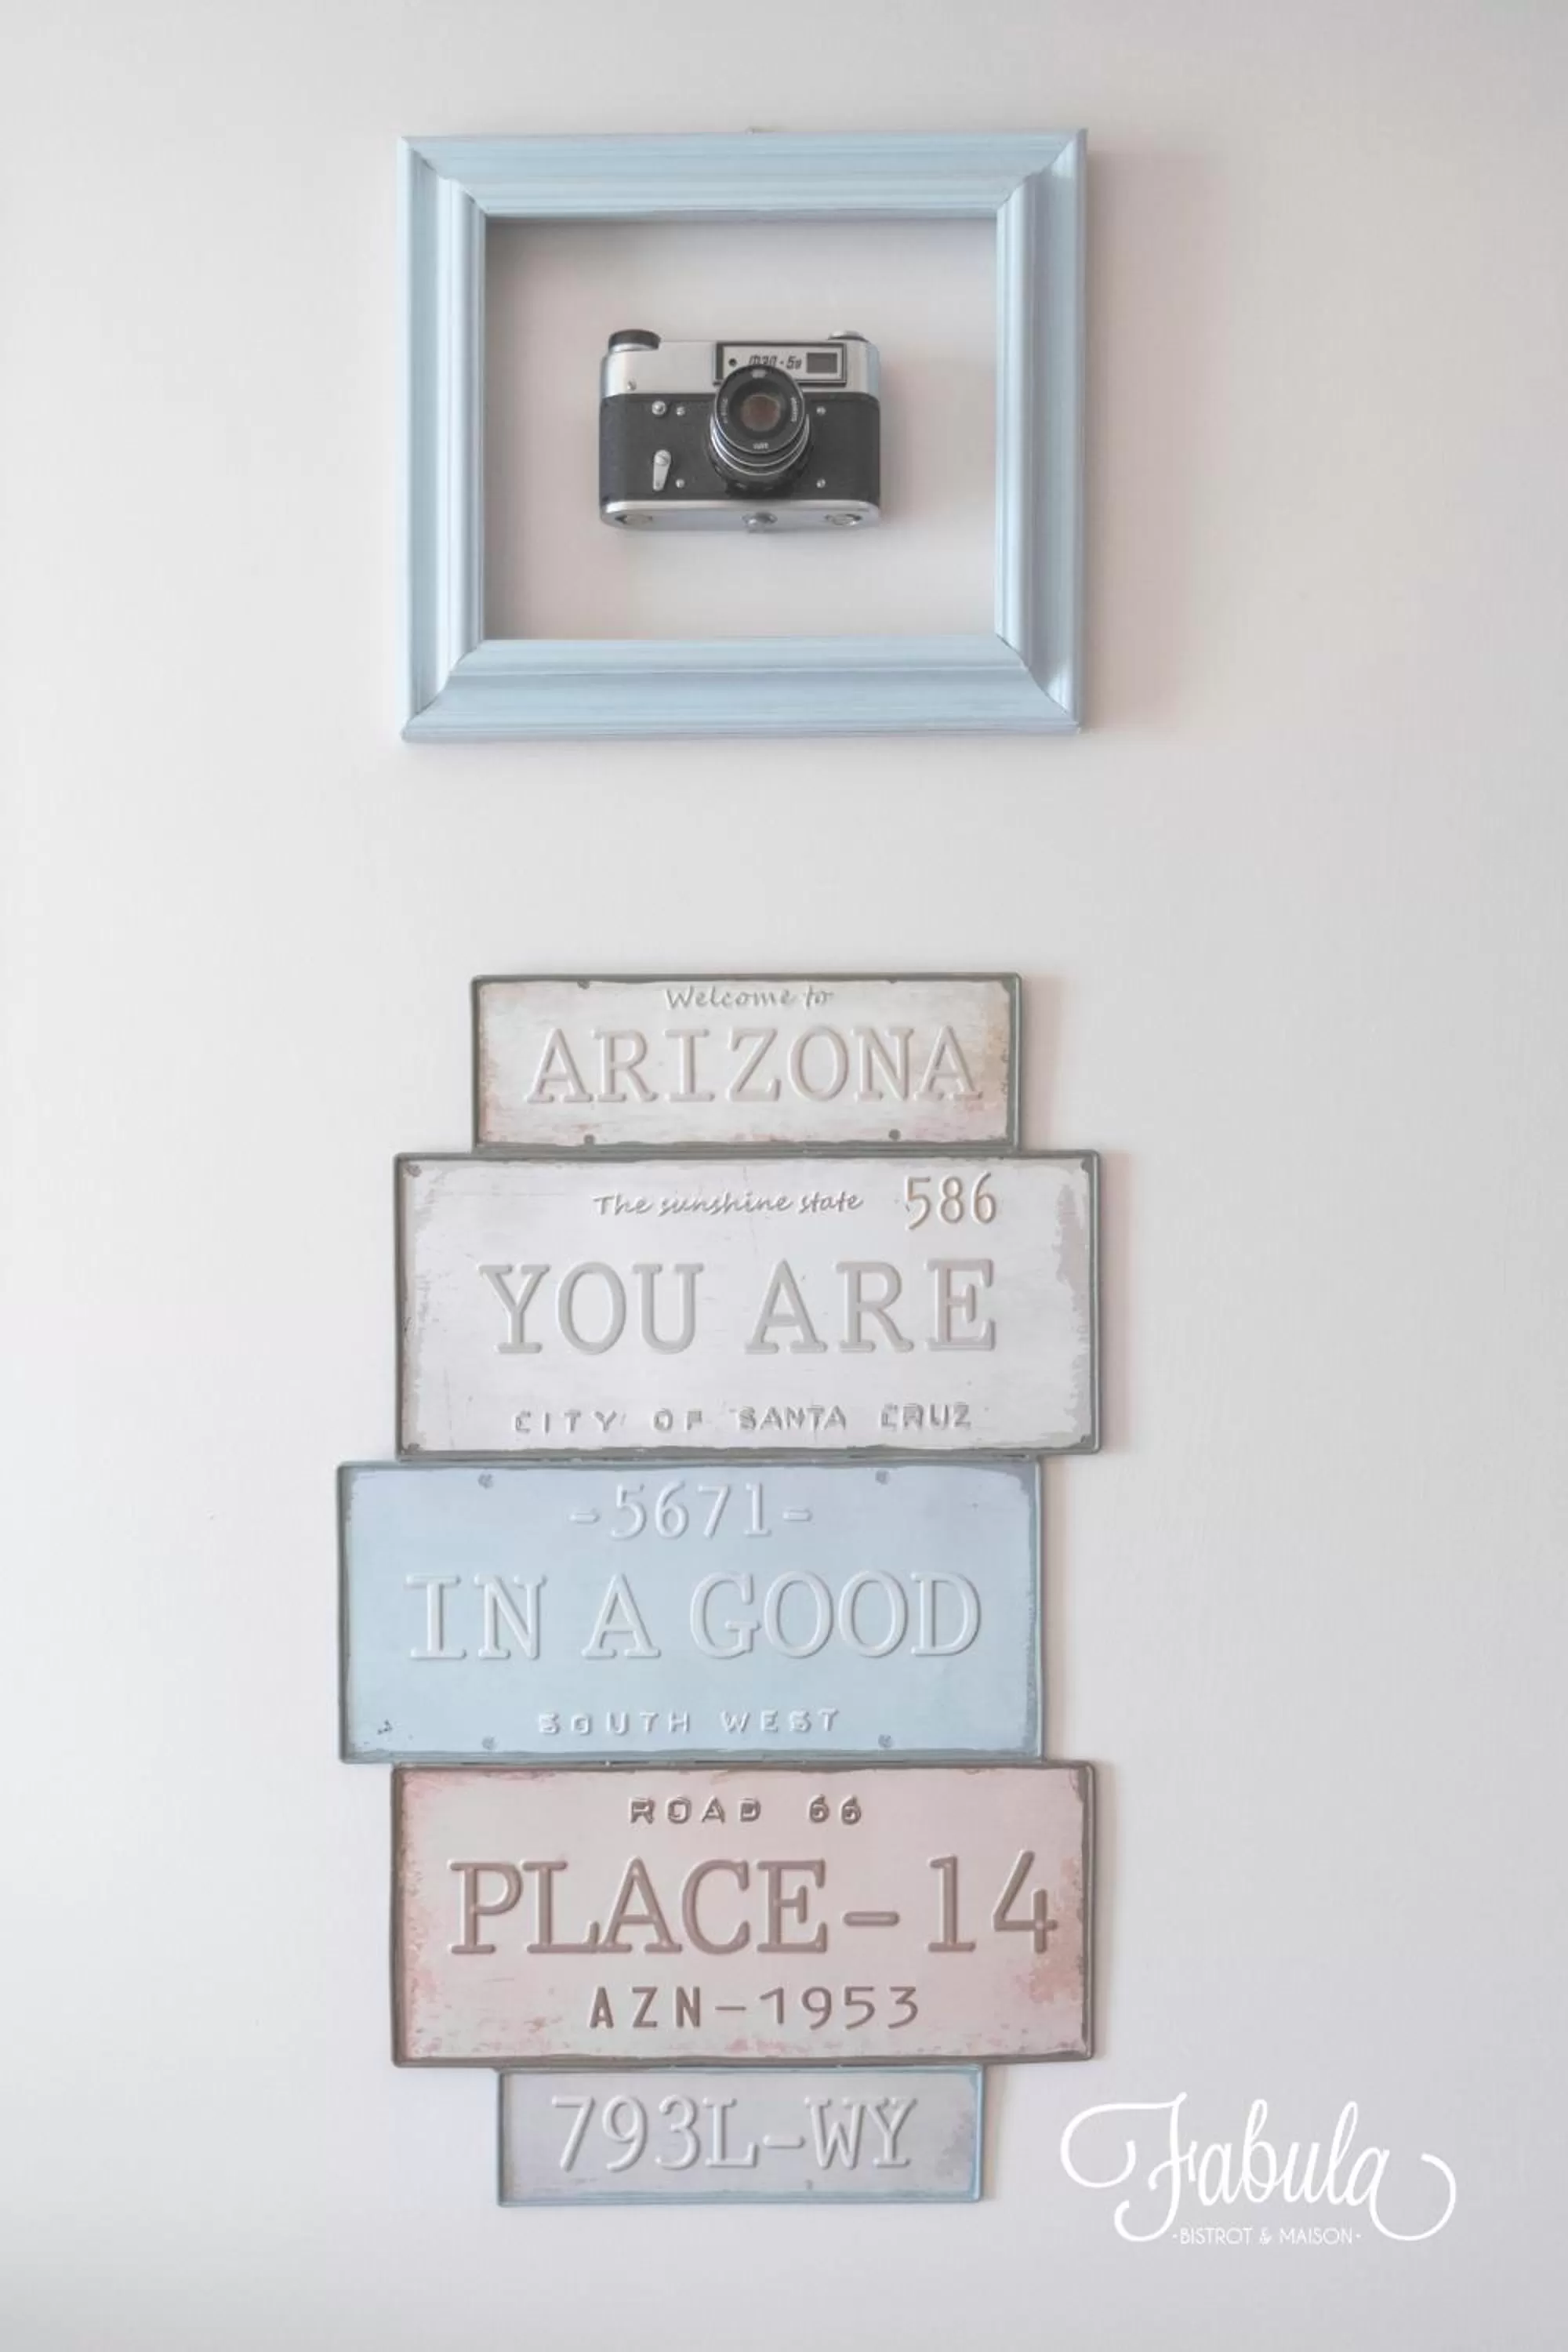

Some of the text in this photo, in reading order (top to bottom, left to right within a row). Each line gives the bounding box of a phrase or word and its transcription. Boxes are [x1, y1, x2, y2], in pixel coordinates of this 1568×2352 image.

[666, 985, 834, 1010] Welcome to
[527, 1025, 983, 1104] ARIZONA
[593, 1192, 865, 1218] The sunshine state
[905, 1171, 999, 1229] 586
[478, 1258, 998, 1355] YOU ARE
[514, 1403, 974, 1433] CITY OF SANTA CRUZ
[405, 1570, 982, 1661] IN A GOOD
[538, 1708, 842, 1736] SOUTH WEST
[630, 1794, 863, 1825] ROAD 66
[447, 1849, 1059, 1956] PLACE-14
[588, 1984, 920, 2031] AZN-1953
[551, 2094, 919, 2172] 793L-WY
